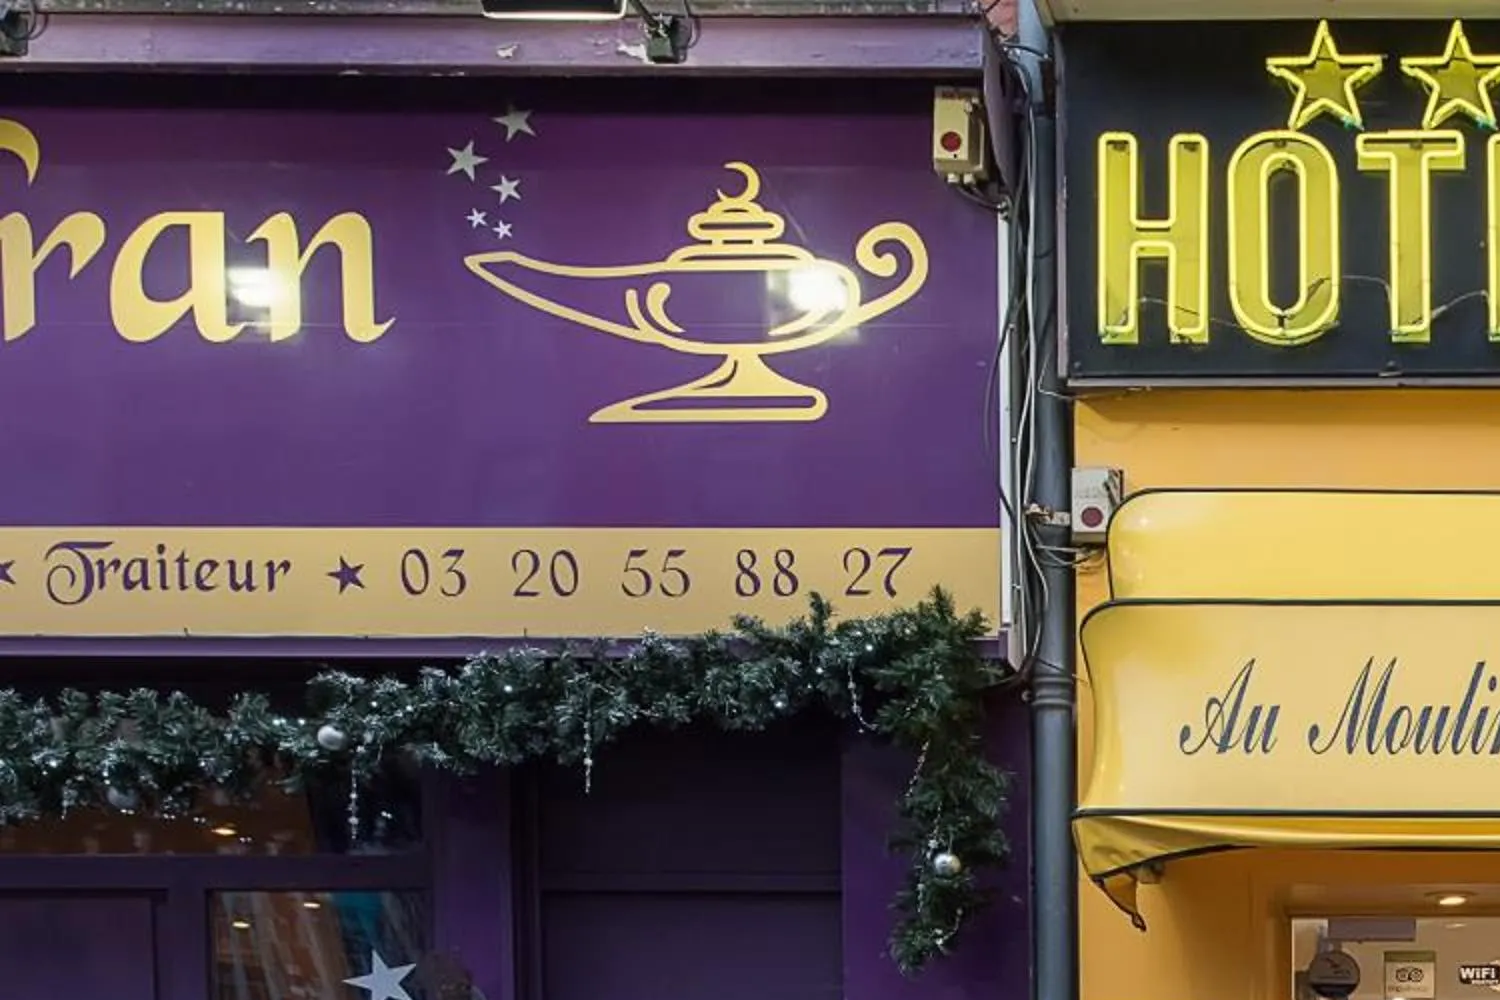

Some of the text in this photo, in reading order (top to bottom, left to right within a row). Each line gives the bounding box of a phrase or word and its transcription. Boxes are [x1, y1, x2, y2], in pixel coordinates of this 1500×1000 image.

[0, 118, 395, 343] ran
[45, 540, 914, 605] Traiteur 03 20 55 88 27
[1179, 657, 1279, 757] Au
